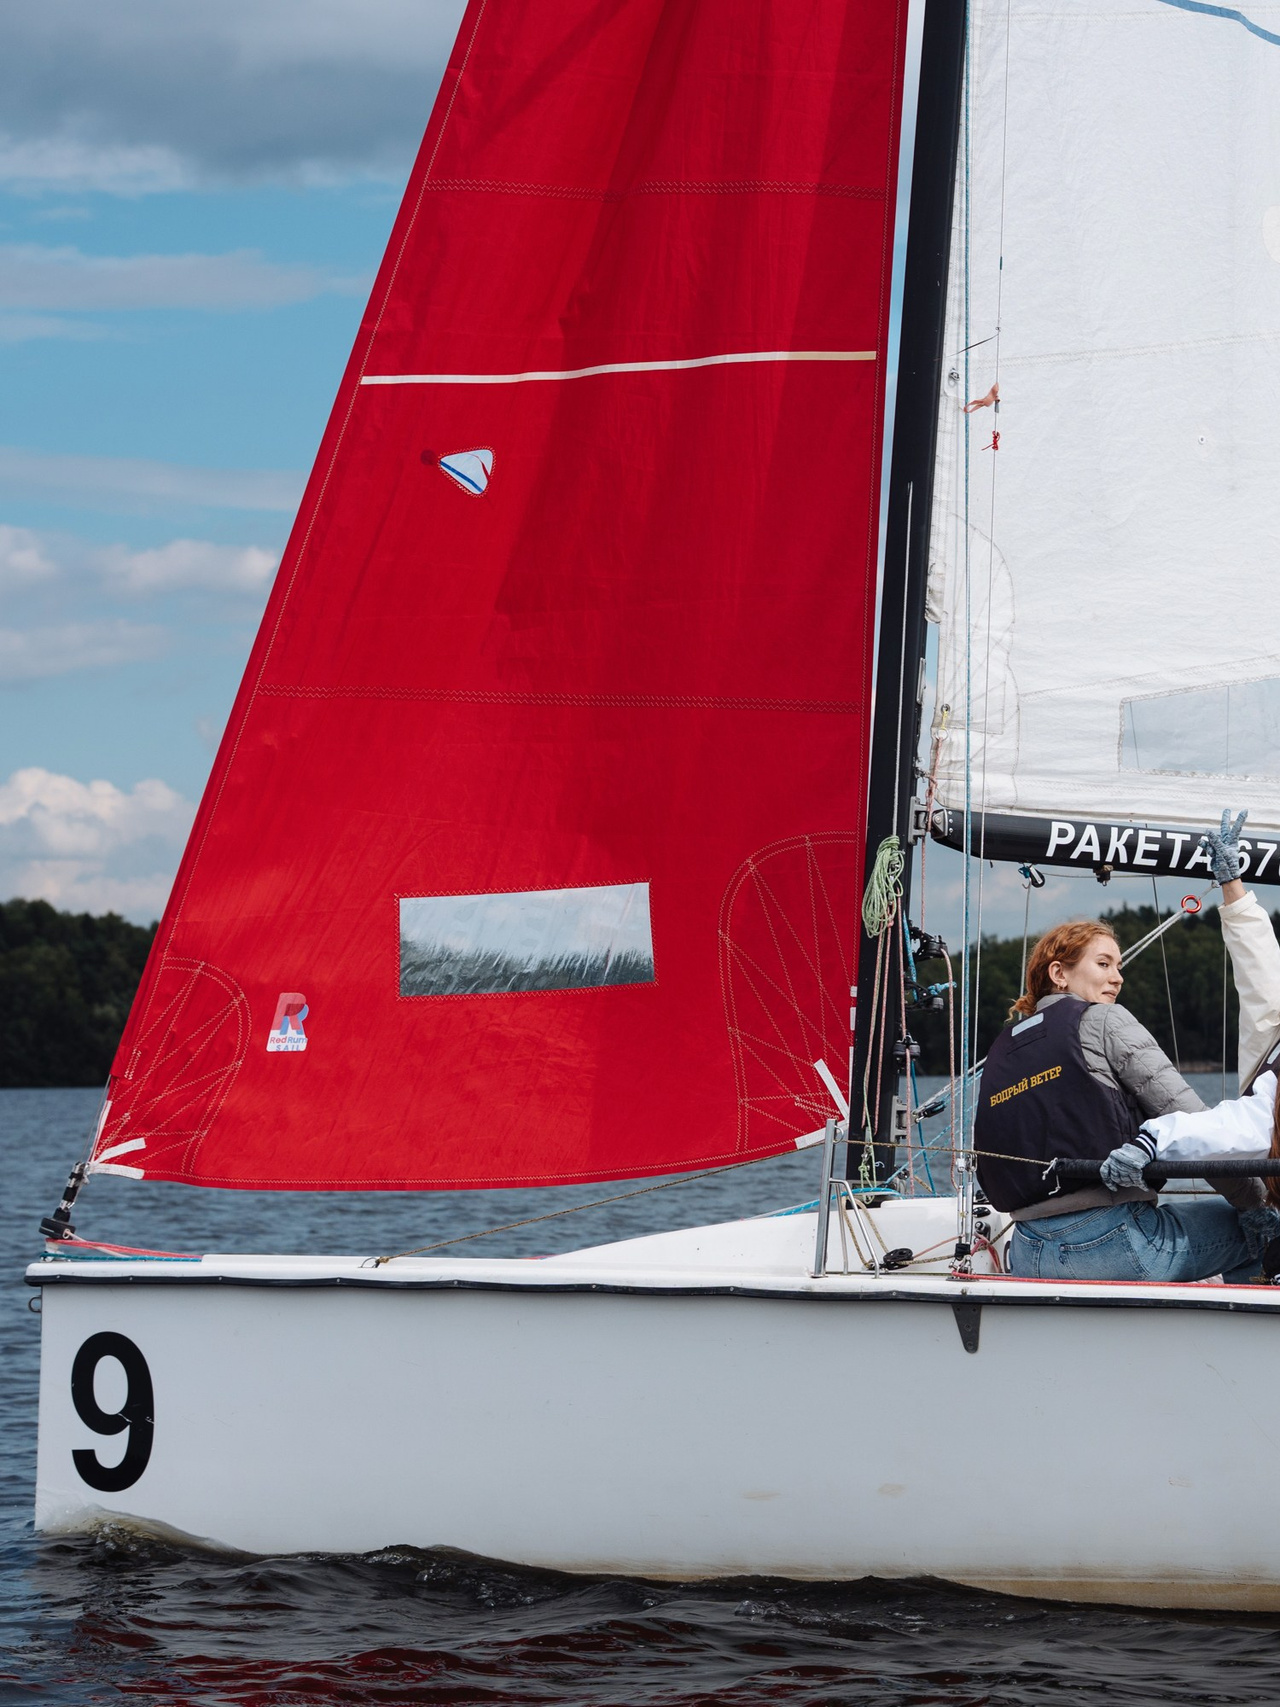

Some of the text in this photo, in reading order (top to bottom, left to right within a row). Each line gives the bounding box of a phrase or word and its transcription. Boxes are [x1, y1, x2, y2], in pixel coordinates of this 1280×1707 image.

[1045, 821, 1213, 872] РАКЕТА
[990, 1065, 1062, 1107] БОДРЫЙ ВЕТЕР
[71, 1331, 154, 1492] 9
